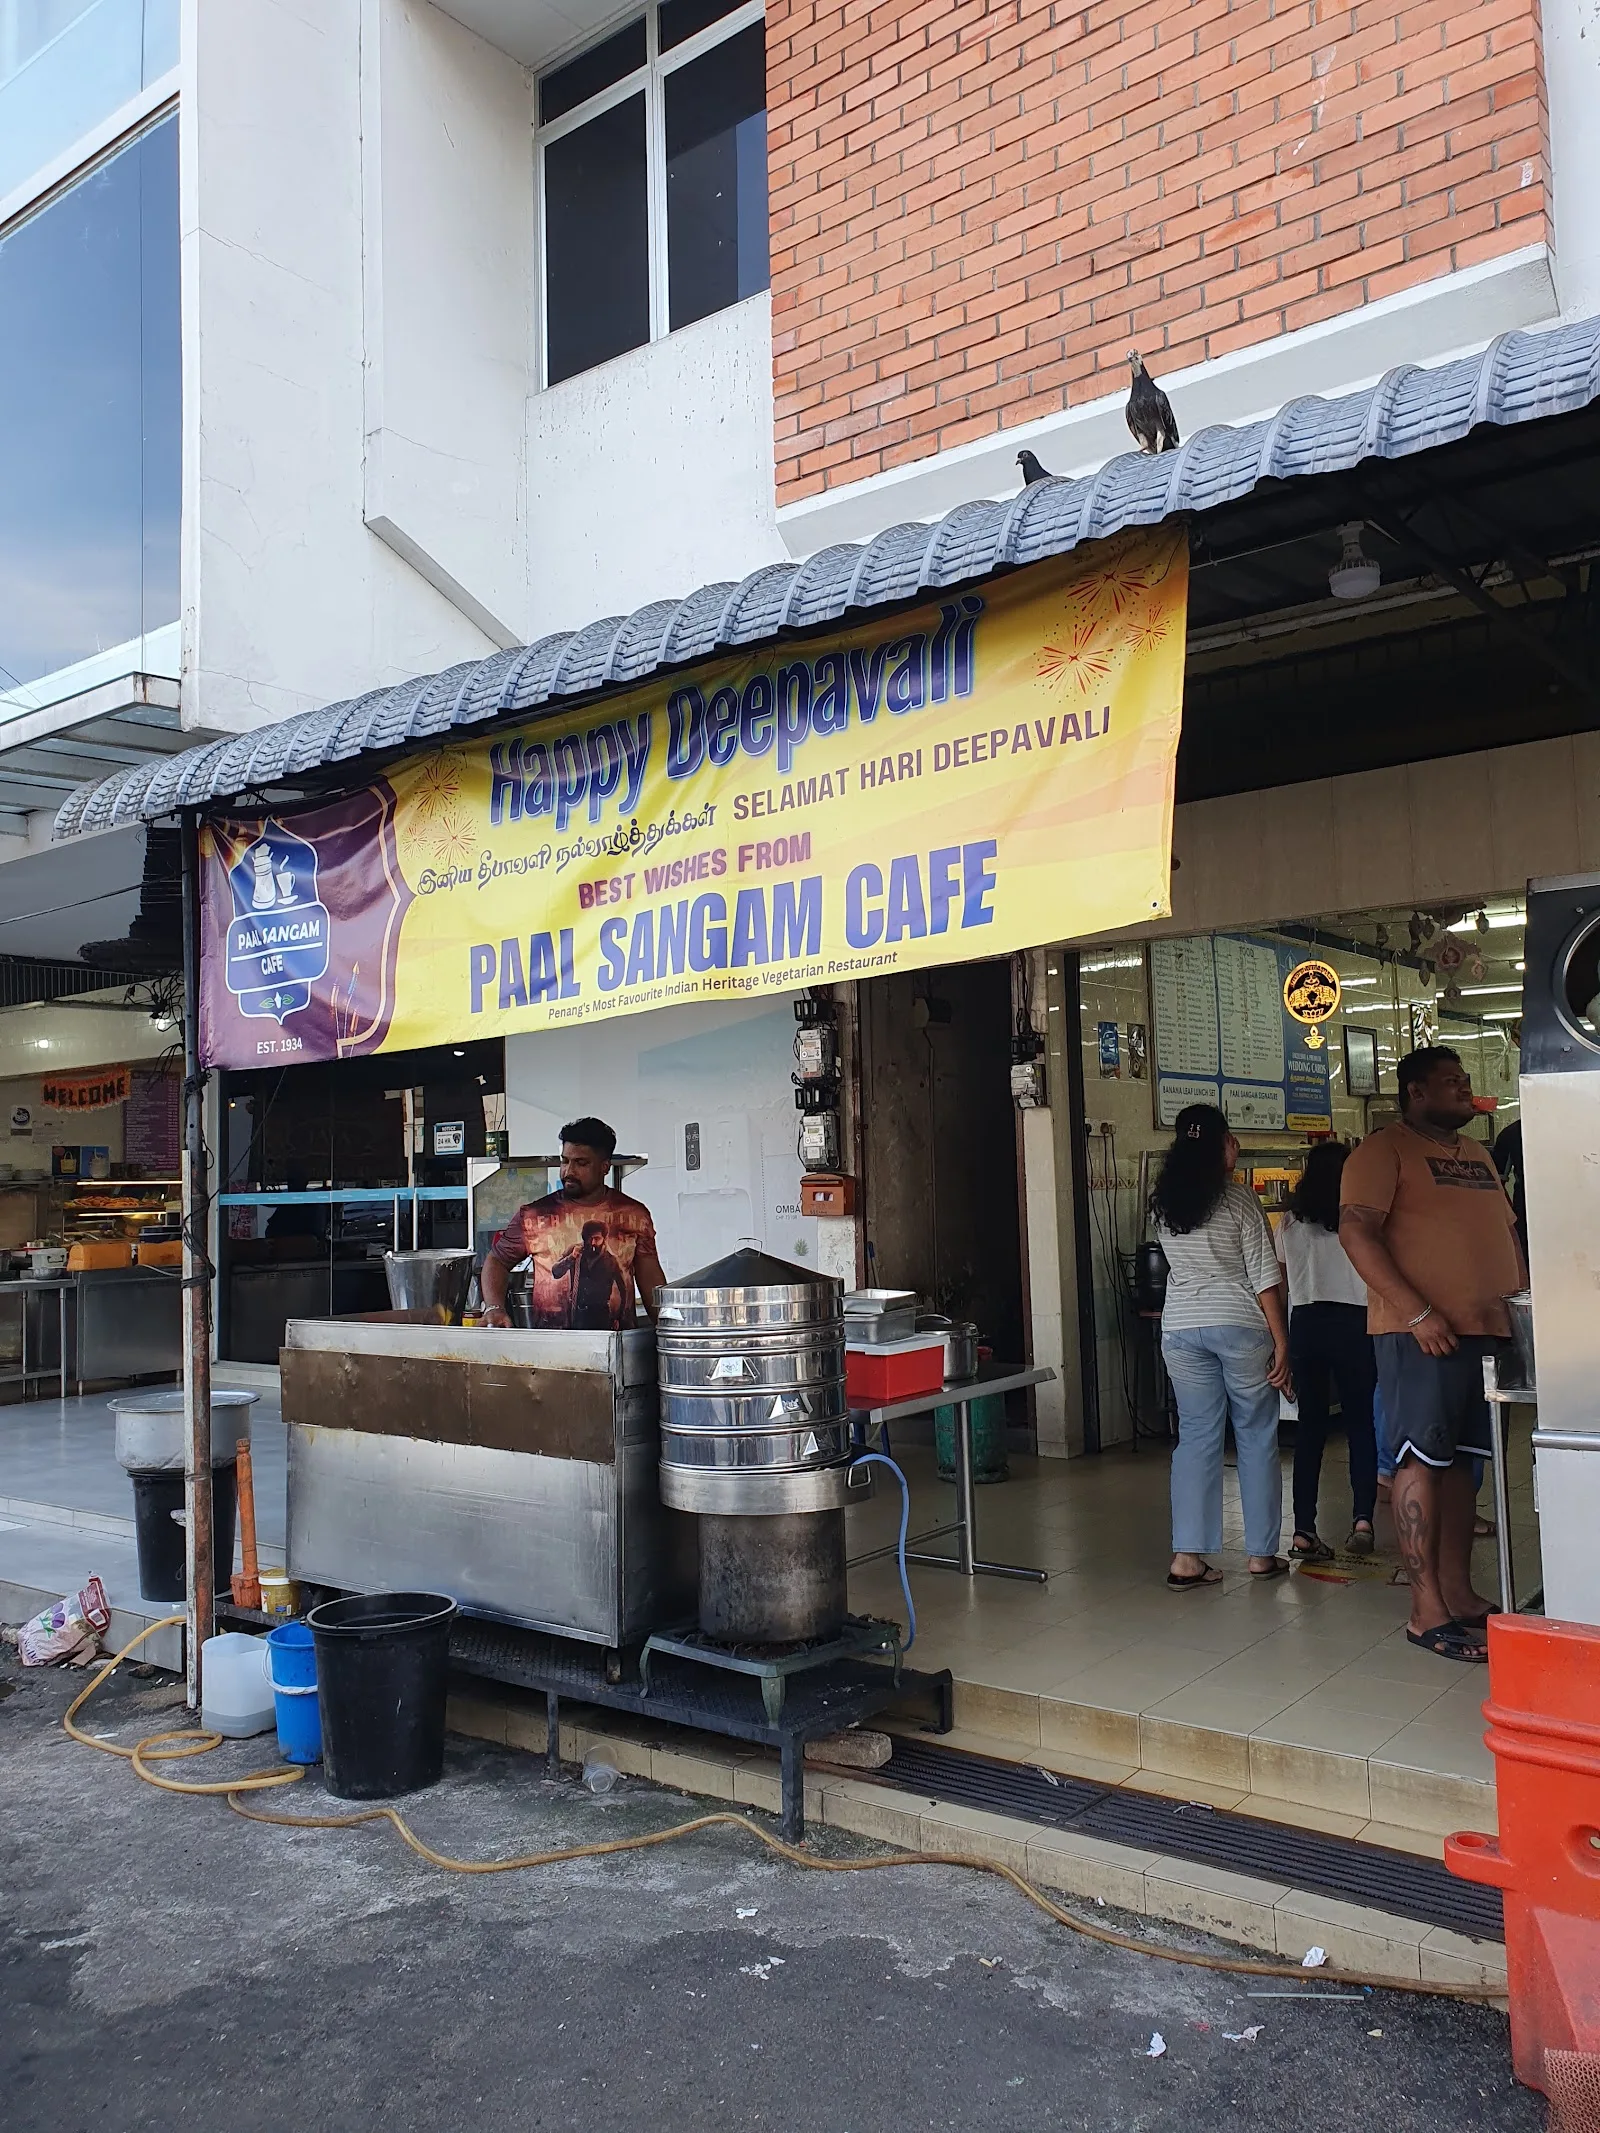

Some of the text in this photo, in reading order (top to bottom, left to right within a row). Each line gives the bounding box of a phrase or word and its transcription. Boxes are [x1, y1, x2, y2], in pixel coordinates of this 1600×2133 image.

[489, 595, 984, 831] Happy Deepavali
[733, 705, 1111, 821] SELAMAT HARI DEEPAVALI
[417, 865, 473, 895] இனிய
[478, 844, 552, 890] தீபாவளி
[578, 831, 812, 910] BEST WISHES FROM
[238, 919, 320, 951] PAAL SANGAM
[470, 839, 998, 1014] PAAL SANGAM CAFE
[261, 954, 284, 976] CAFE
[548, 951, 898, 1020] Penang's Most Favourite Indian Heritage Vegetarian Restaurant
[257, 1037, 303, 1054] EST. 1934
[1288, 1060, 1311, 1073] WEDDING
[43, 1076, 125, 1106] WELCOME
